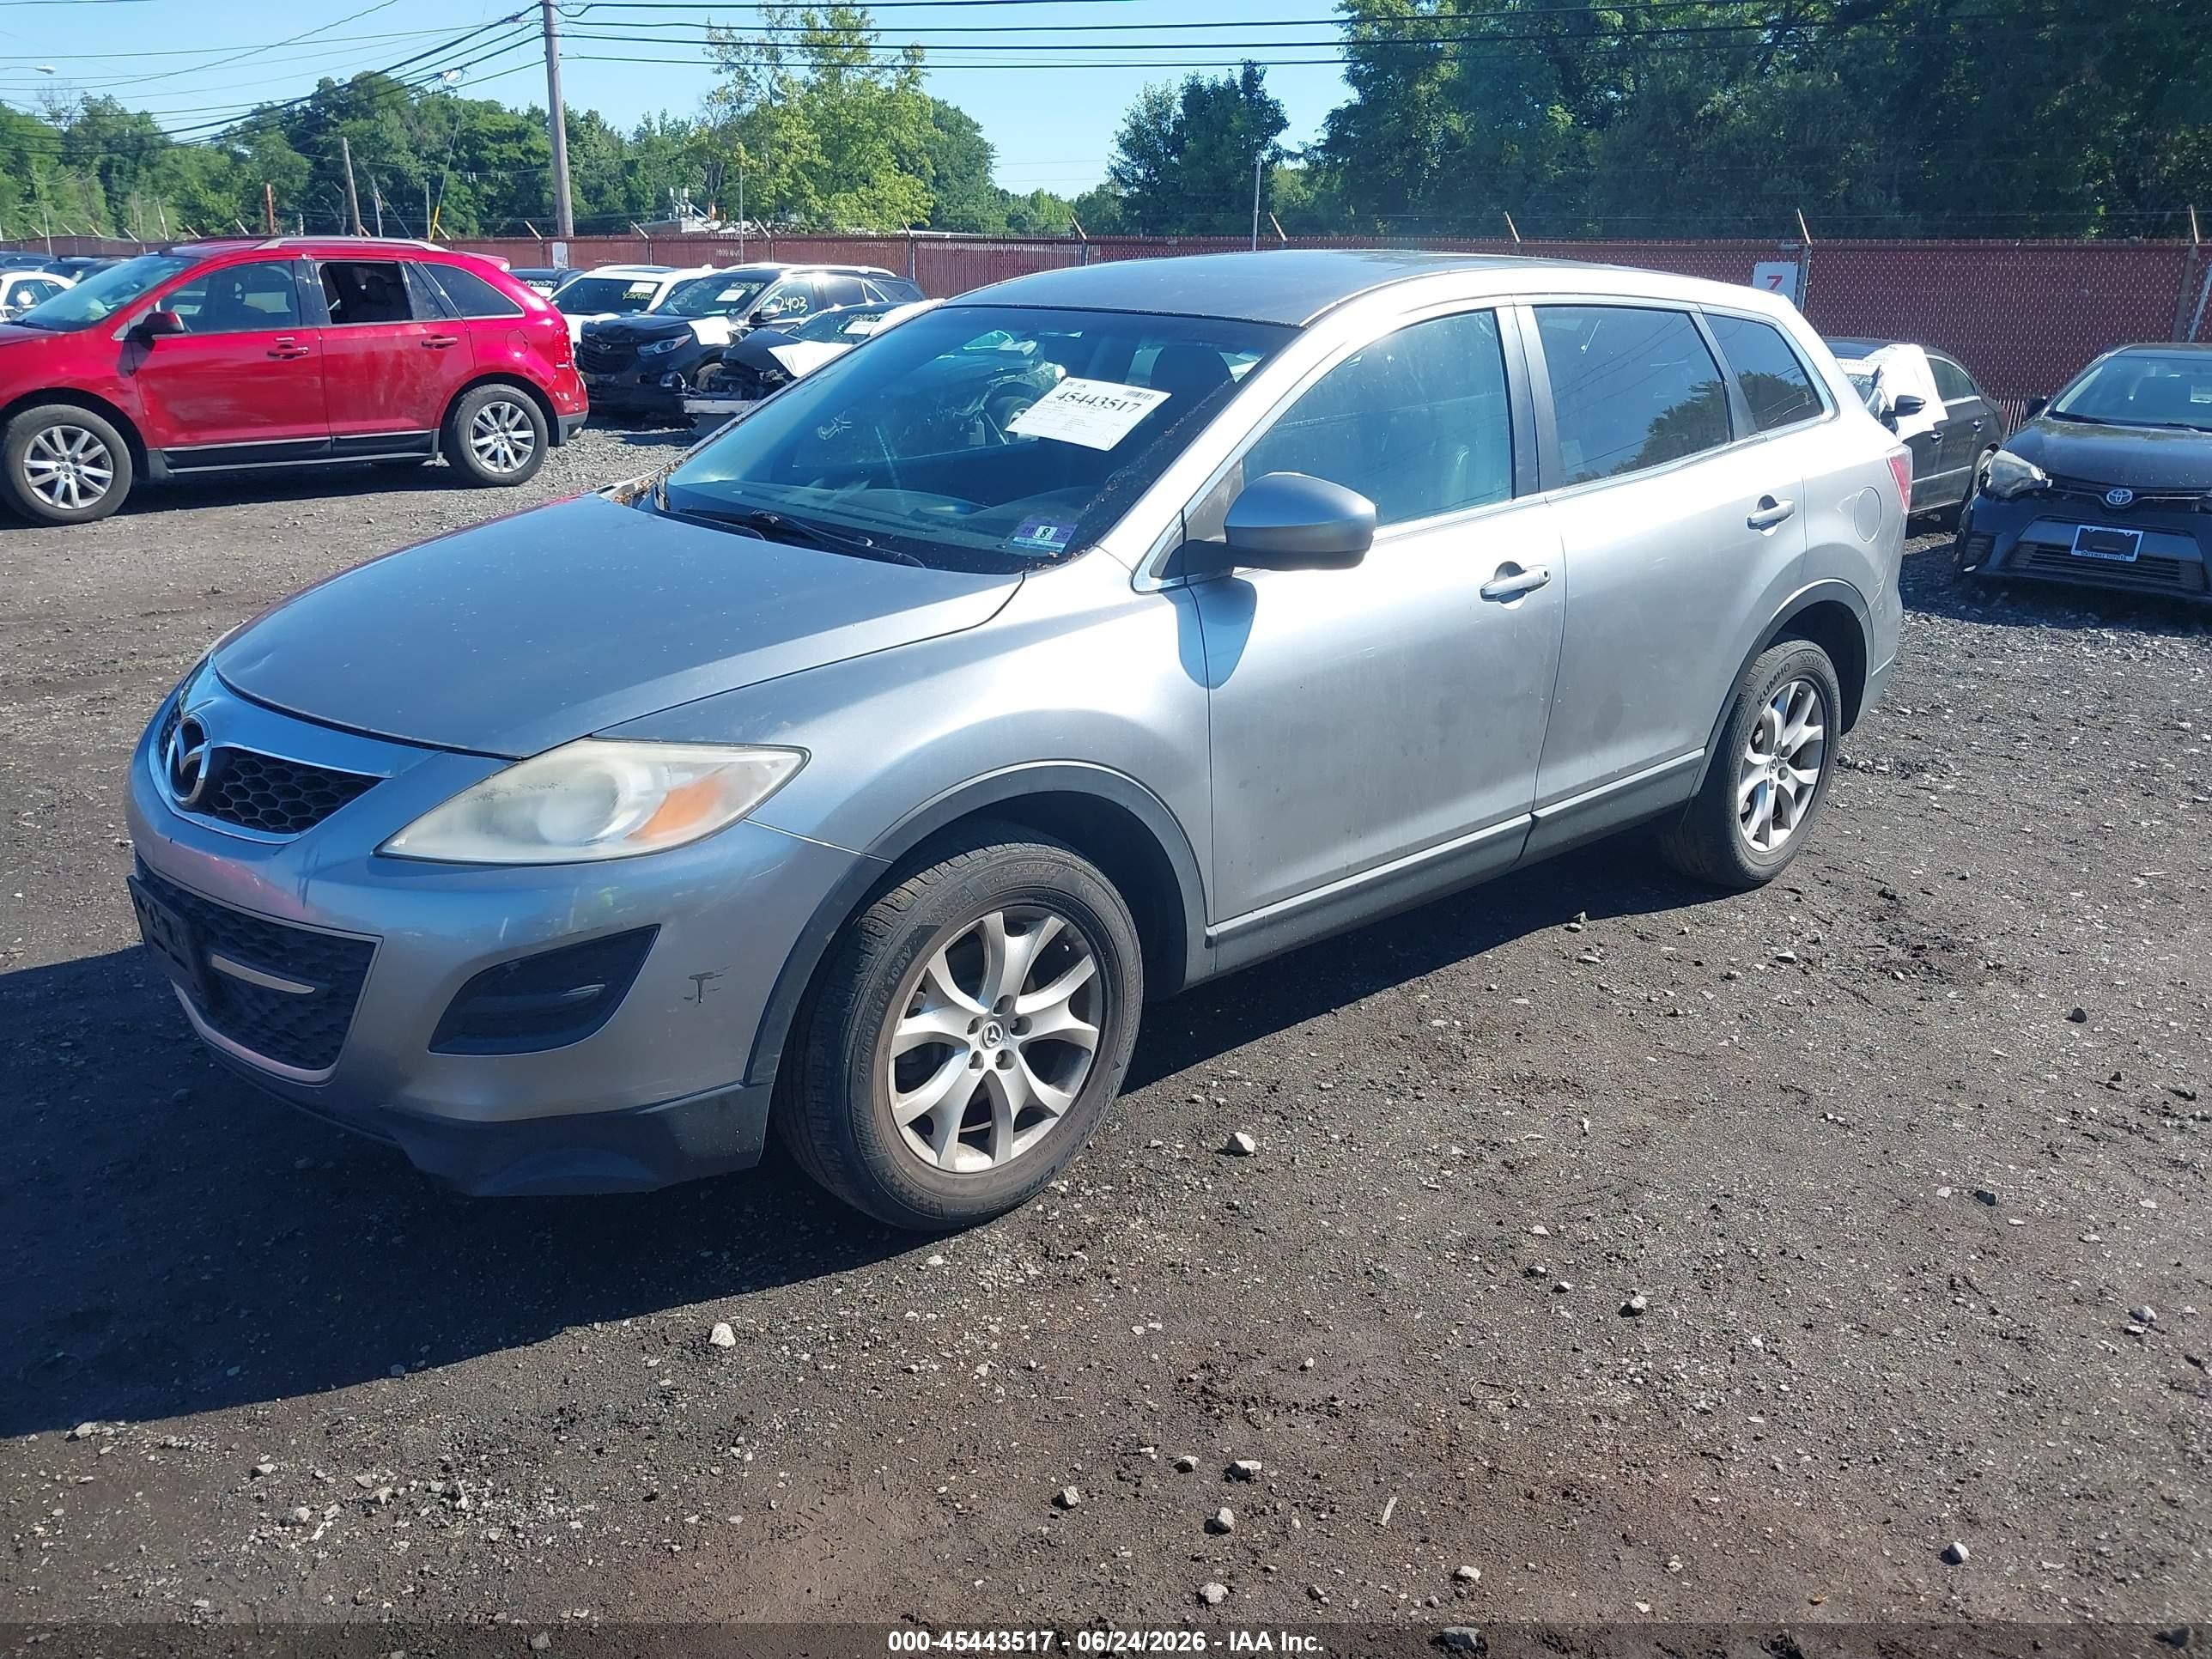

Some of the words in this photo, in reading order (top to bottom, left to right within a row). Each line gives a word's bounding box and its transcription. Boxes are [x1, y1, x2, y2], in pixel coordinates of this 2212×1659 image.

[1766, 275, 1784, 290] 7
[775, 295, 808, 314] 2403
[1055, 391, 1143, 414] 45443517
[1039, 527, 1051, 539] 8
[1757, 662, 1790, 707] KUMHO
[886, 944, 913, 986] 106V
